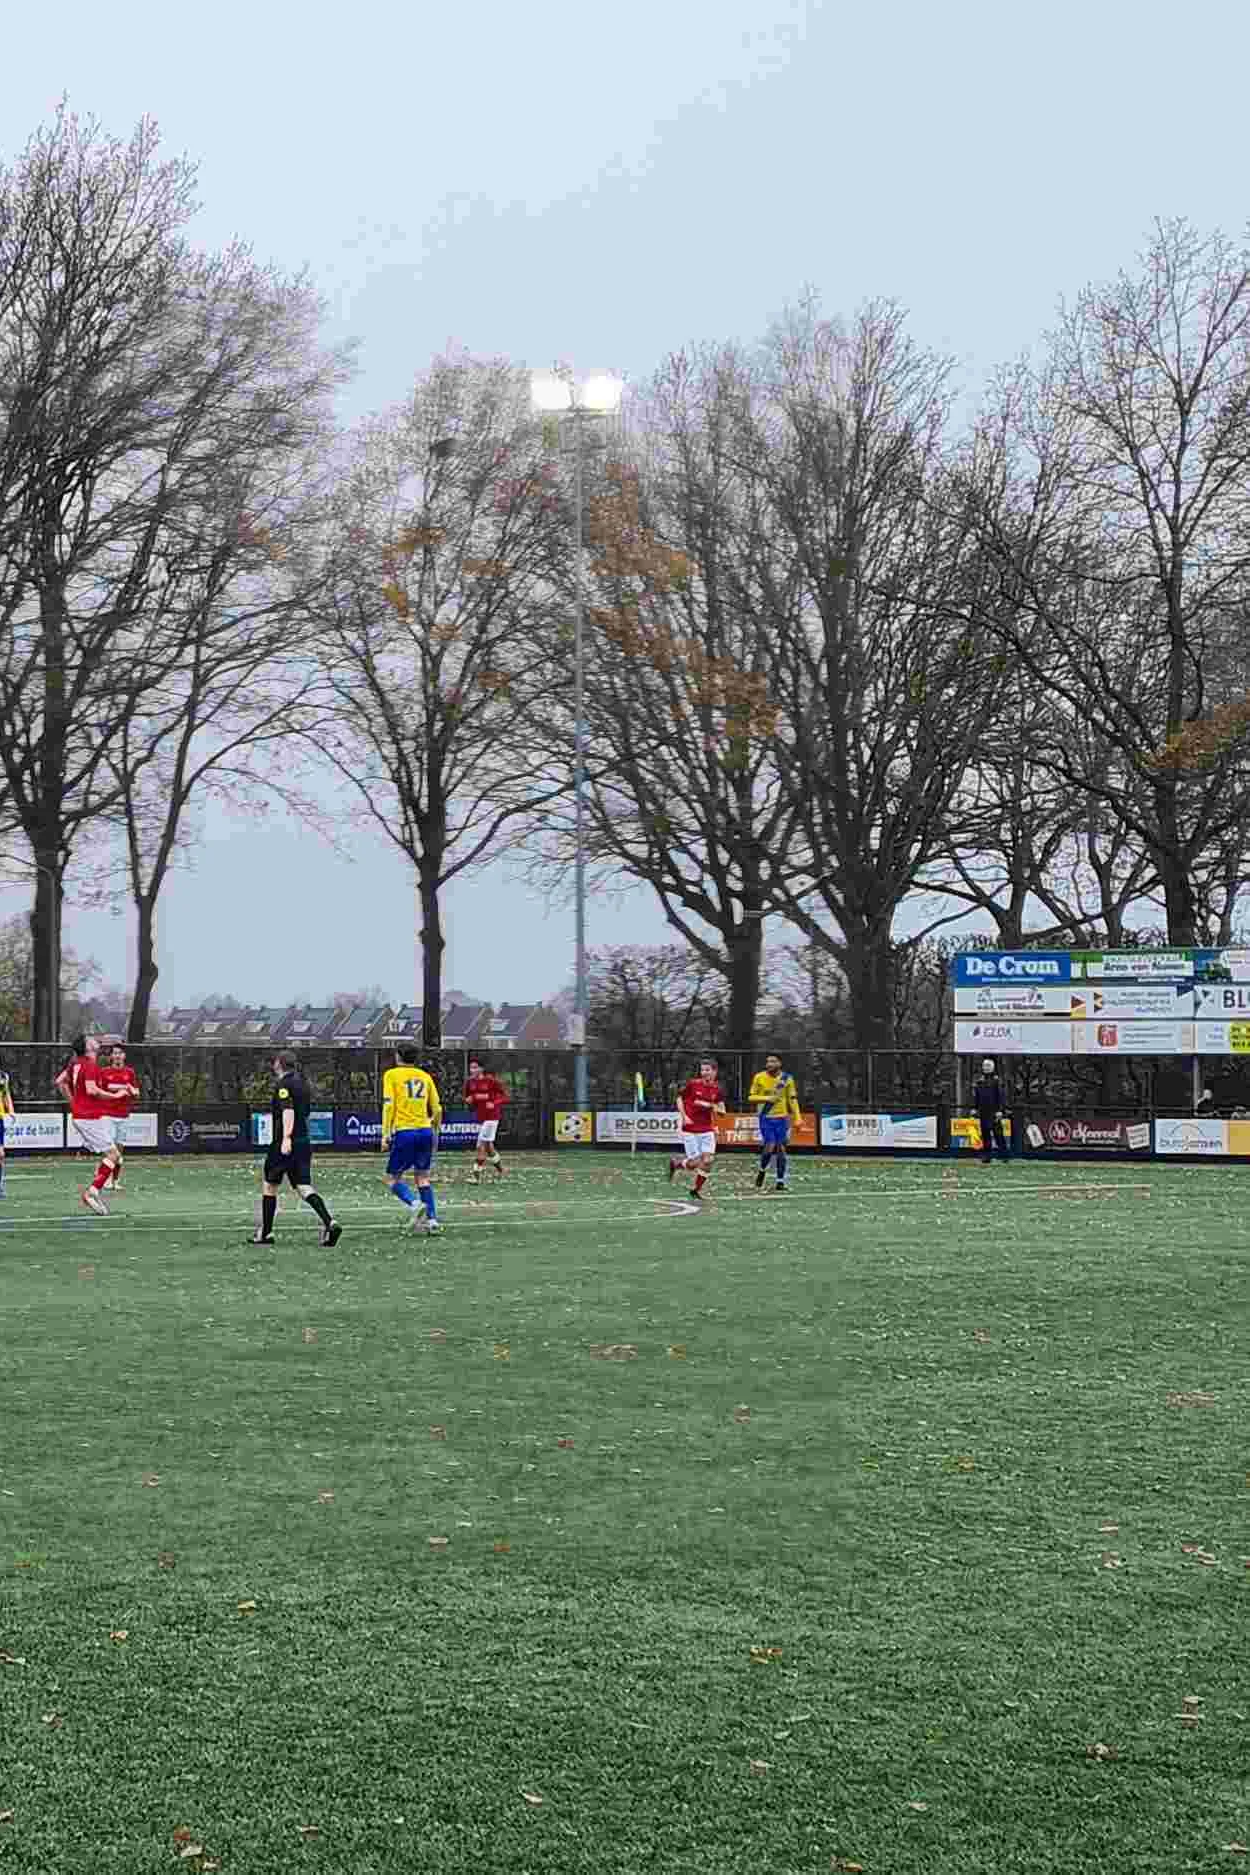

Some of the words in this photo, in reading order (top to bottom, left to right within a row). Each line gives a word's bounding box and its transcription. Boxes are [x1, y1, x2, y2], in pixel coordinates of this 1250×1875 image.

[965, 956, 996, 976] De
[998, 955, 1061, 976] Crom
[1222, 989, 1250, 1009] BL
[404, 1079, 426, 1098] 12
